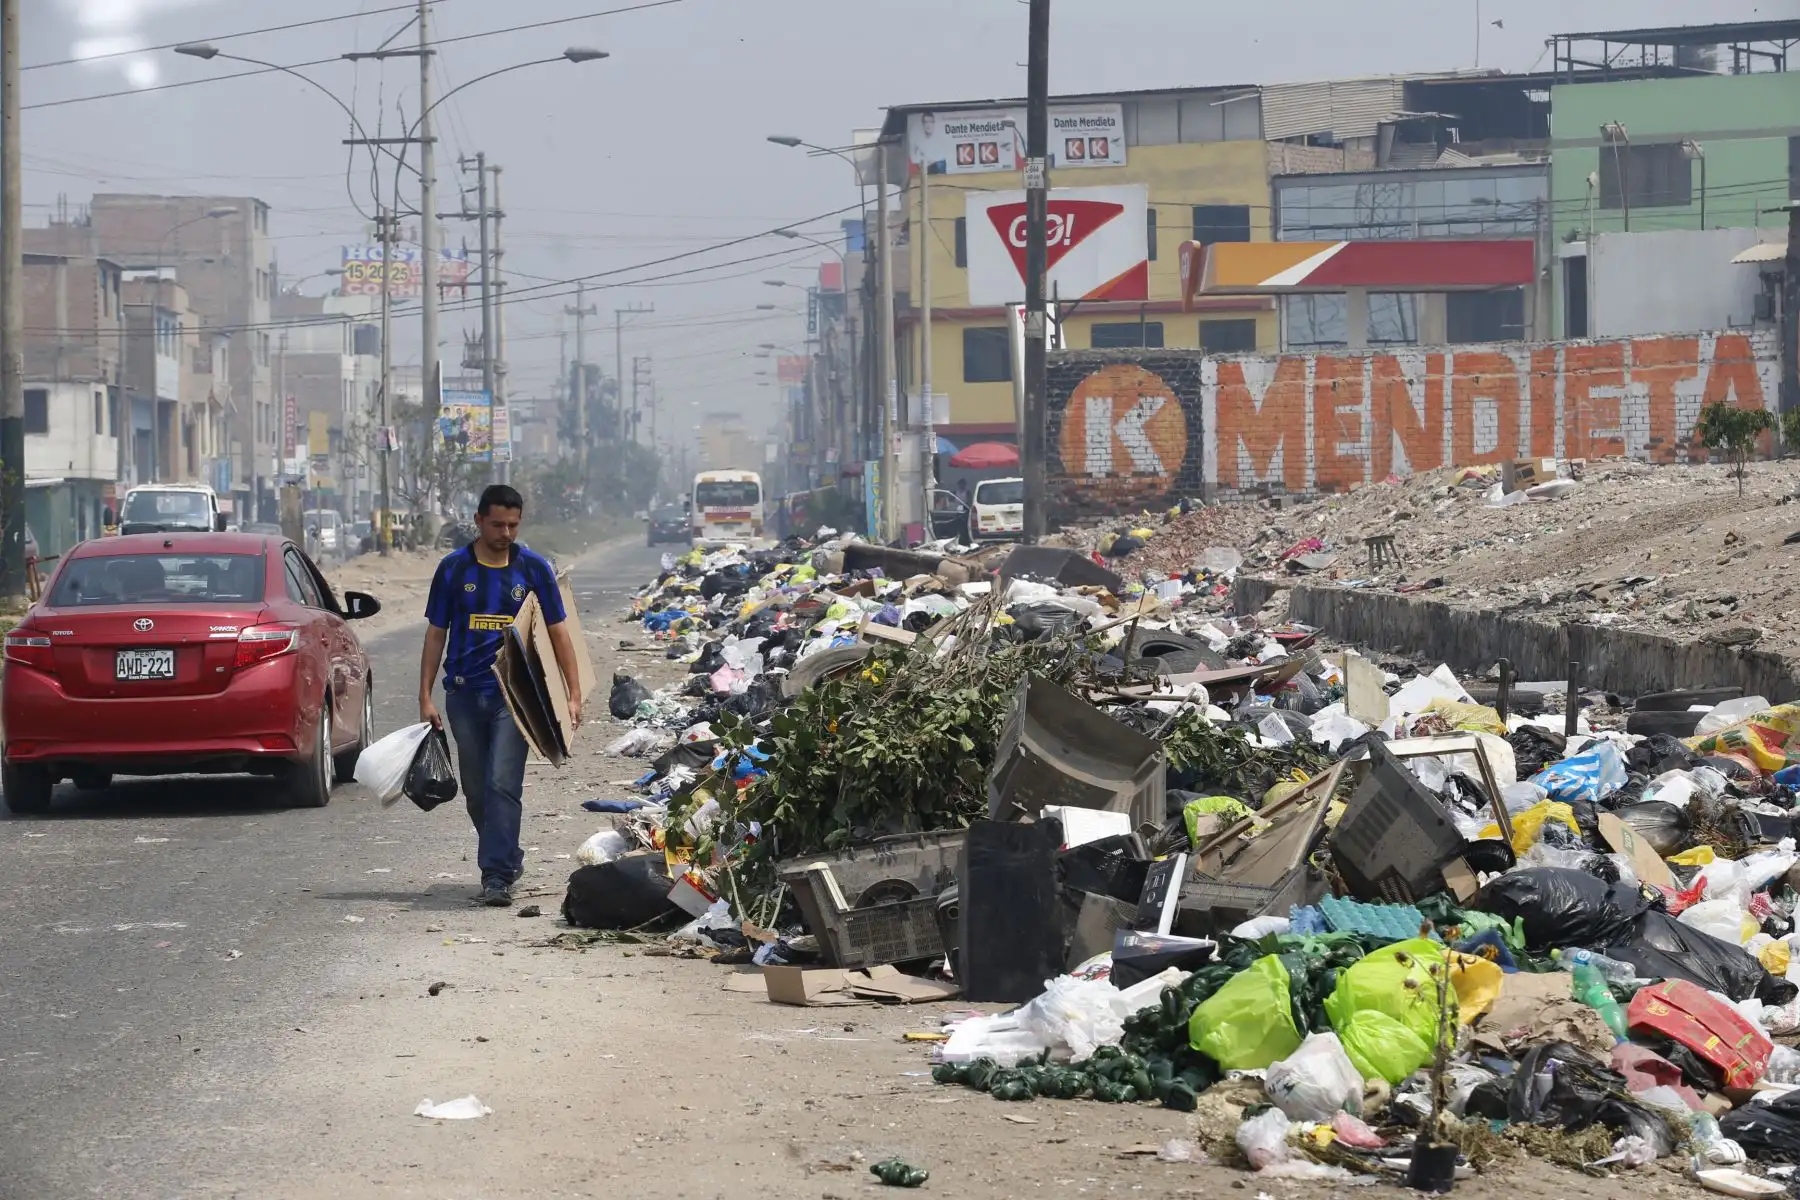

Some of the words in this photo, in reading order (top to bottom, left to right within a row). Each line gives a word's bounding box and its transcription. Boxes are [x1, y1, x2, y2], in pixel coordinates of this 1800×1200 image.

[944, 123, 969, 134] Dante
[969, 120, 1005, 133] Mendieta
[1053, 118, 1078, 128] Dante
[1079, 115, 1116, 127] Mendieta
[348, 264, 363, 279] 15
[392, 267, 408, 280] 25
[1216, 334, 1774, 494] MENDIETA
[1085, 396, 1168, 479] K
